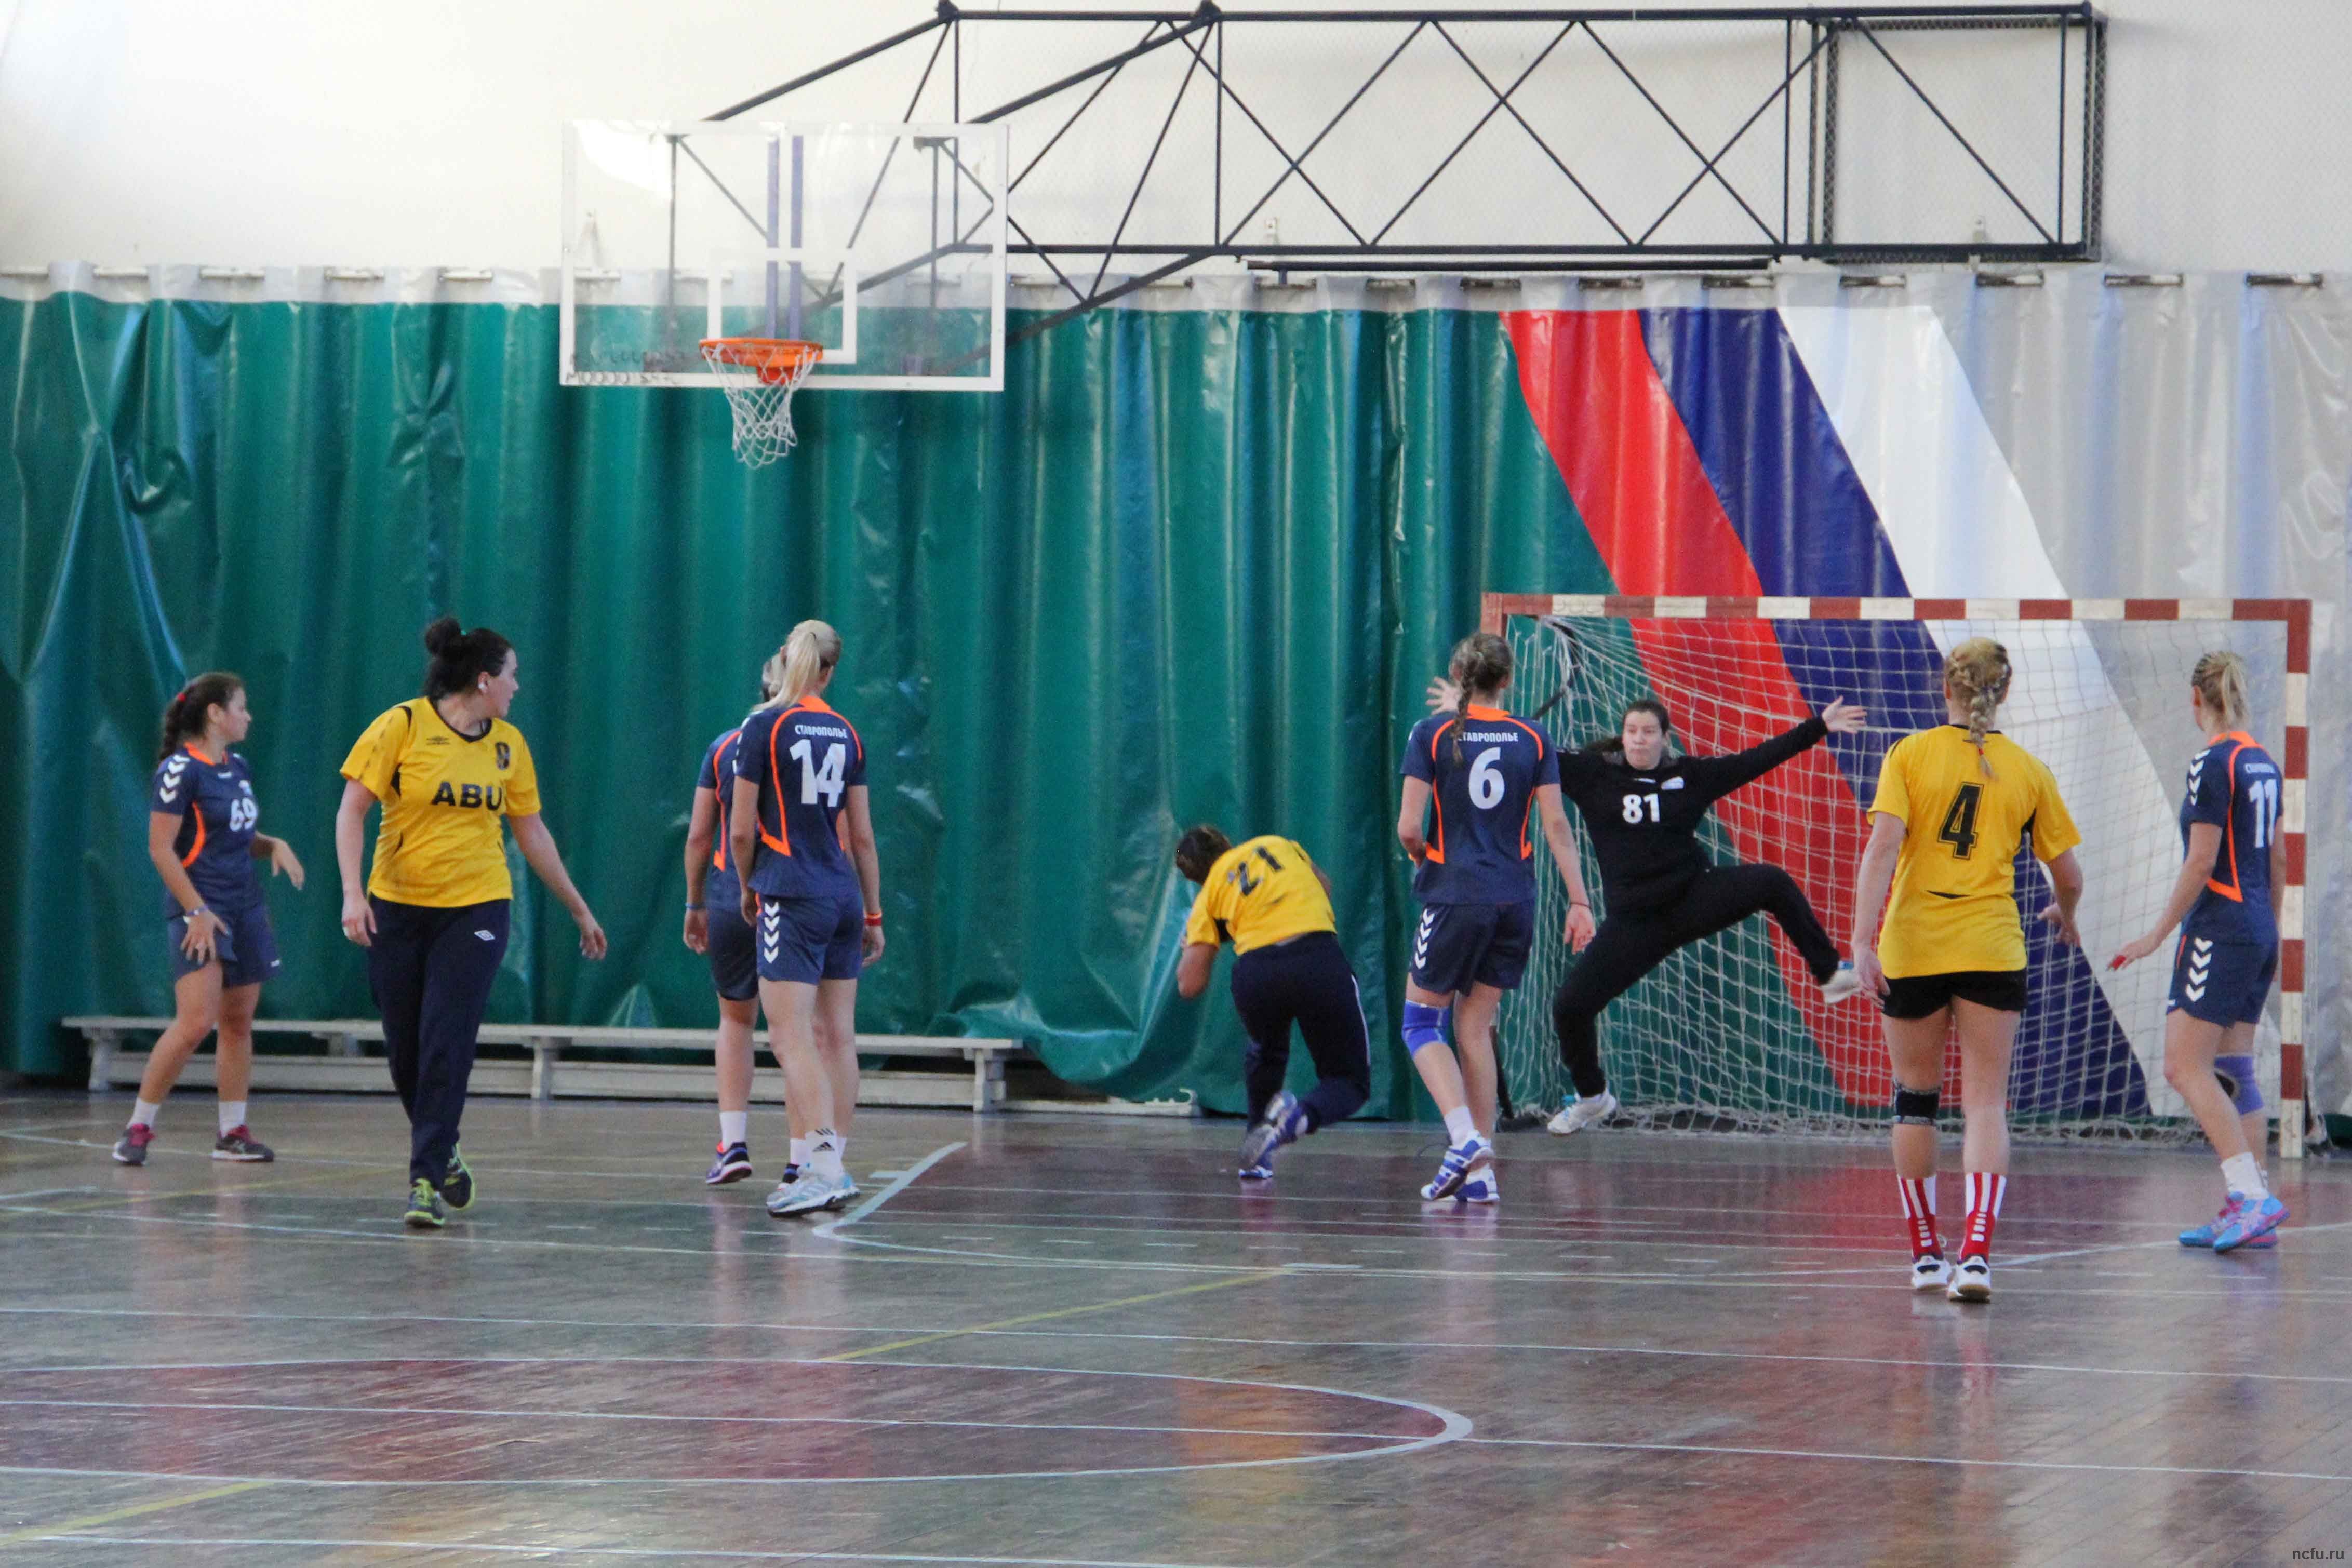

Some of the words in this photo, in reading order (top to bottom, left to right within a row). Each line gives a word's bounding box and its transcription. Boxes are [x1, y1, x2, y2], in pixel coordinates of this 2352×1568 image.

[1458, 732, 1519, 742] ТАВРОПОЛЬЕ
[431, 781, 502, 811] ABU
[789, 739, 846, 807] 14
[1468, 747, 1505, 809] 6
[229, 797, 257, 832] 69
[1622, 793, 1660, 824] 81
[1937, 781, 1984, 860] 4
[2249, 779, 2278, 848] 11
